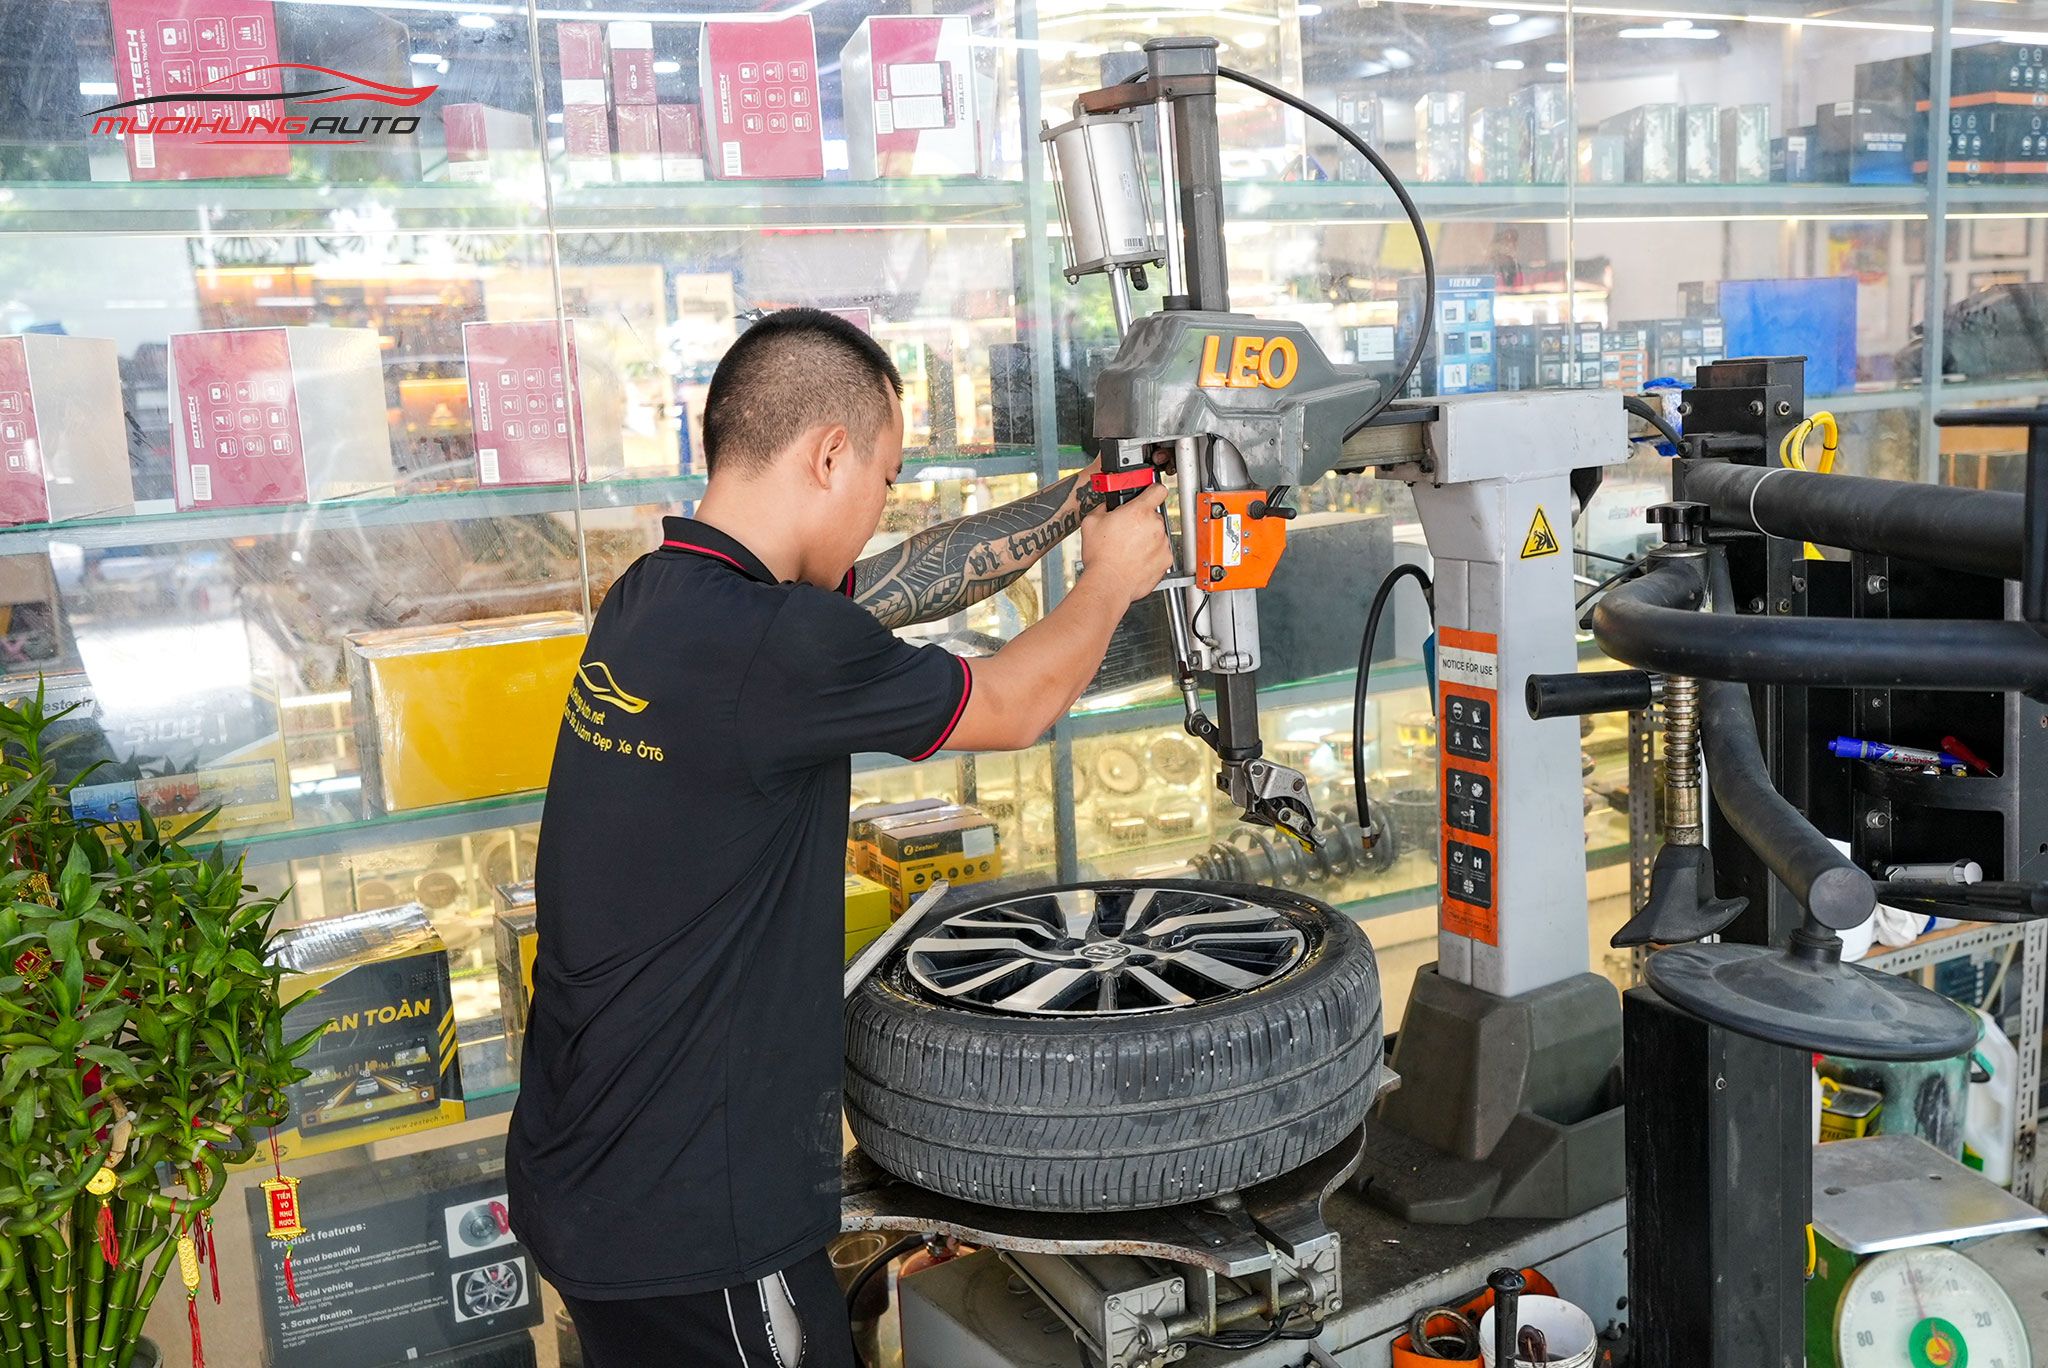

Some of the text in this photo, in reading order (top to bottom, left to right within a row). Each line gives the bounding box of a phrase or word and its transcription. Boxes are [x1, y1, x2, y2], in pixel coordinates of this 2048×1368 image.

[1197, 335, 1299, 389] LEO
[1443, 659, 1493, 675] NOTICE FOR USE
[43, 696, 92, 712] estech
[593, 732, 613, 752] Đẹp
[617, 739, 633, 754] Xe
[324, 998, 431, 1035] AN TOÀN
[271, 1222, 367, 1250] Product features:
[302, 1253, 321, 1266] and
[321, 1245, 362, 1261] beautiful
[1898, 1268, 1925, 1285] 100
[1944, 1279, 1959, 1292] 10
[277, 1294, 286, 1304] 2.
[321, 1279, 355, 1295] vehicle
[1870, 1290, 1885, 1304] 90
[280, 1307, 353, 1331] 3. Screw fixation
[1974, 1311, 1993, 1328] 20
[1856, 1329, 1874, 1347] 80
